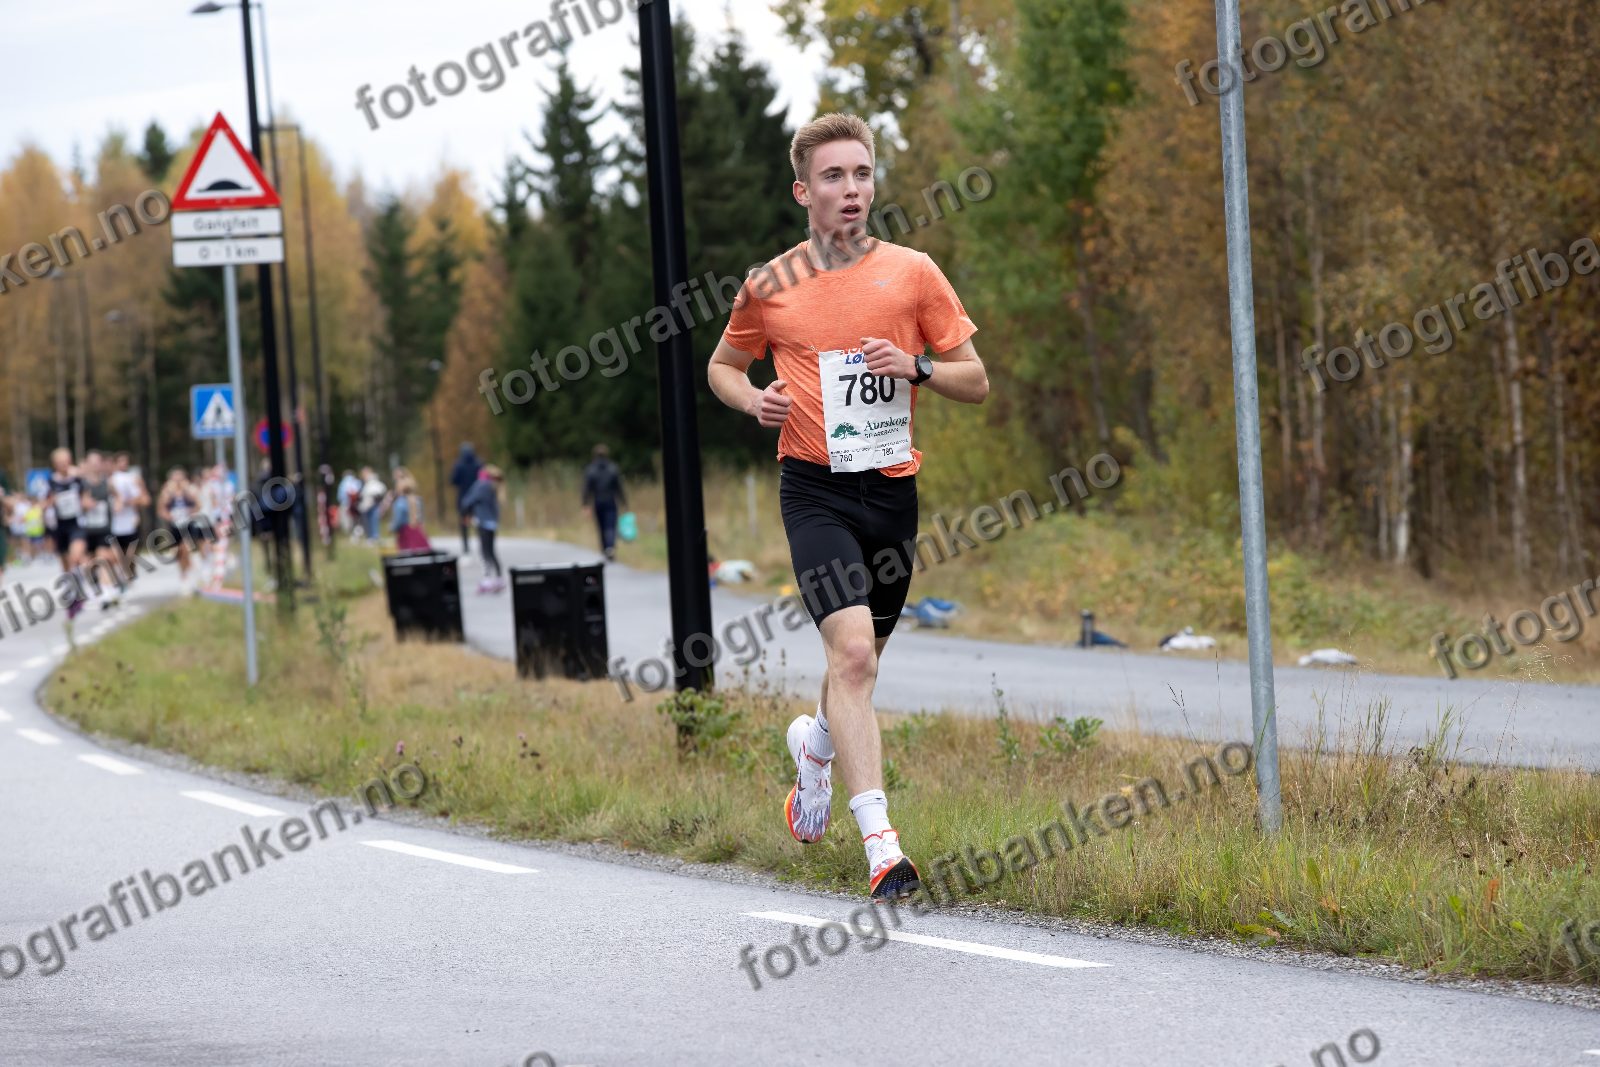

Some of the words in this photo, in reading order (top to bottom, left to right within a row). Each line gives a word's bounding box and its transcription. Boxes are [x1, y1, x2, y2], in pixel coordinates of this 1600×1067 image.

[839, 371, 896, 406] 780
[864, 416, 908, 431] Aurskog
[881, 447, 894, 456] 780
[839, 453, 853, 463] 780
